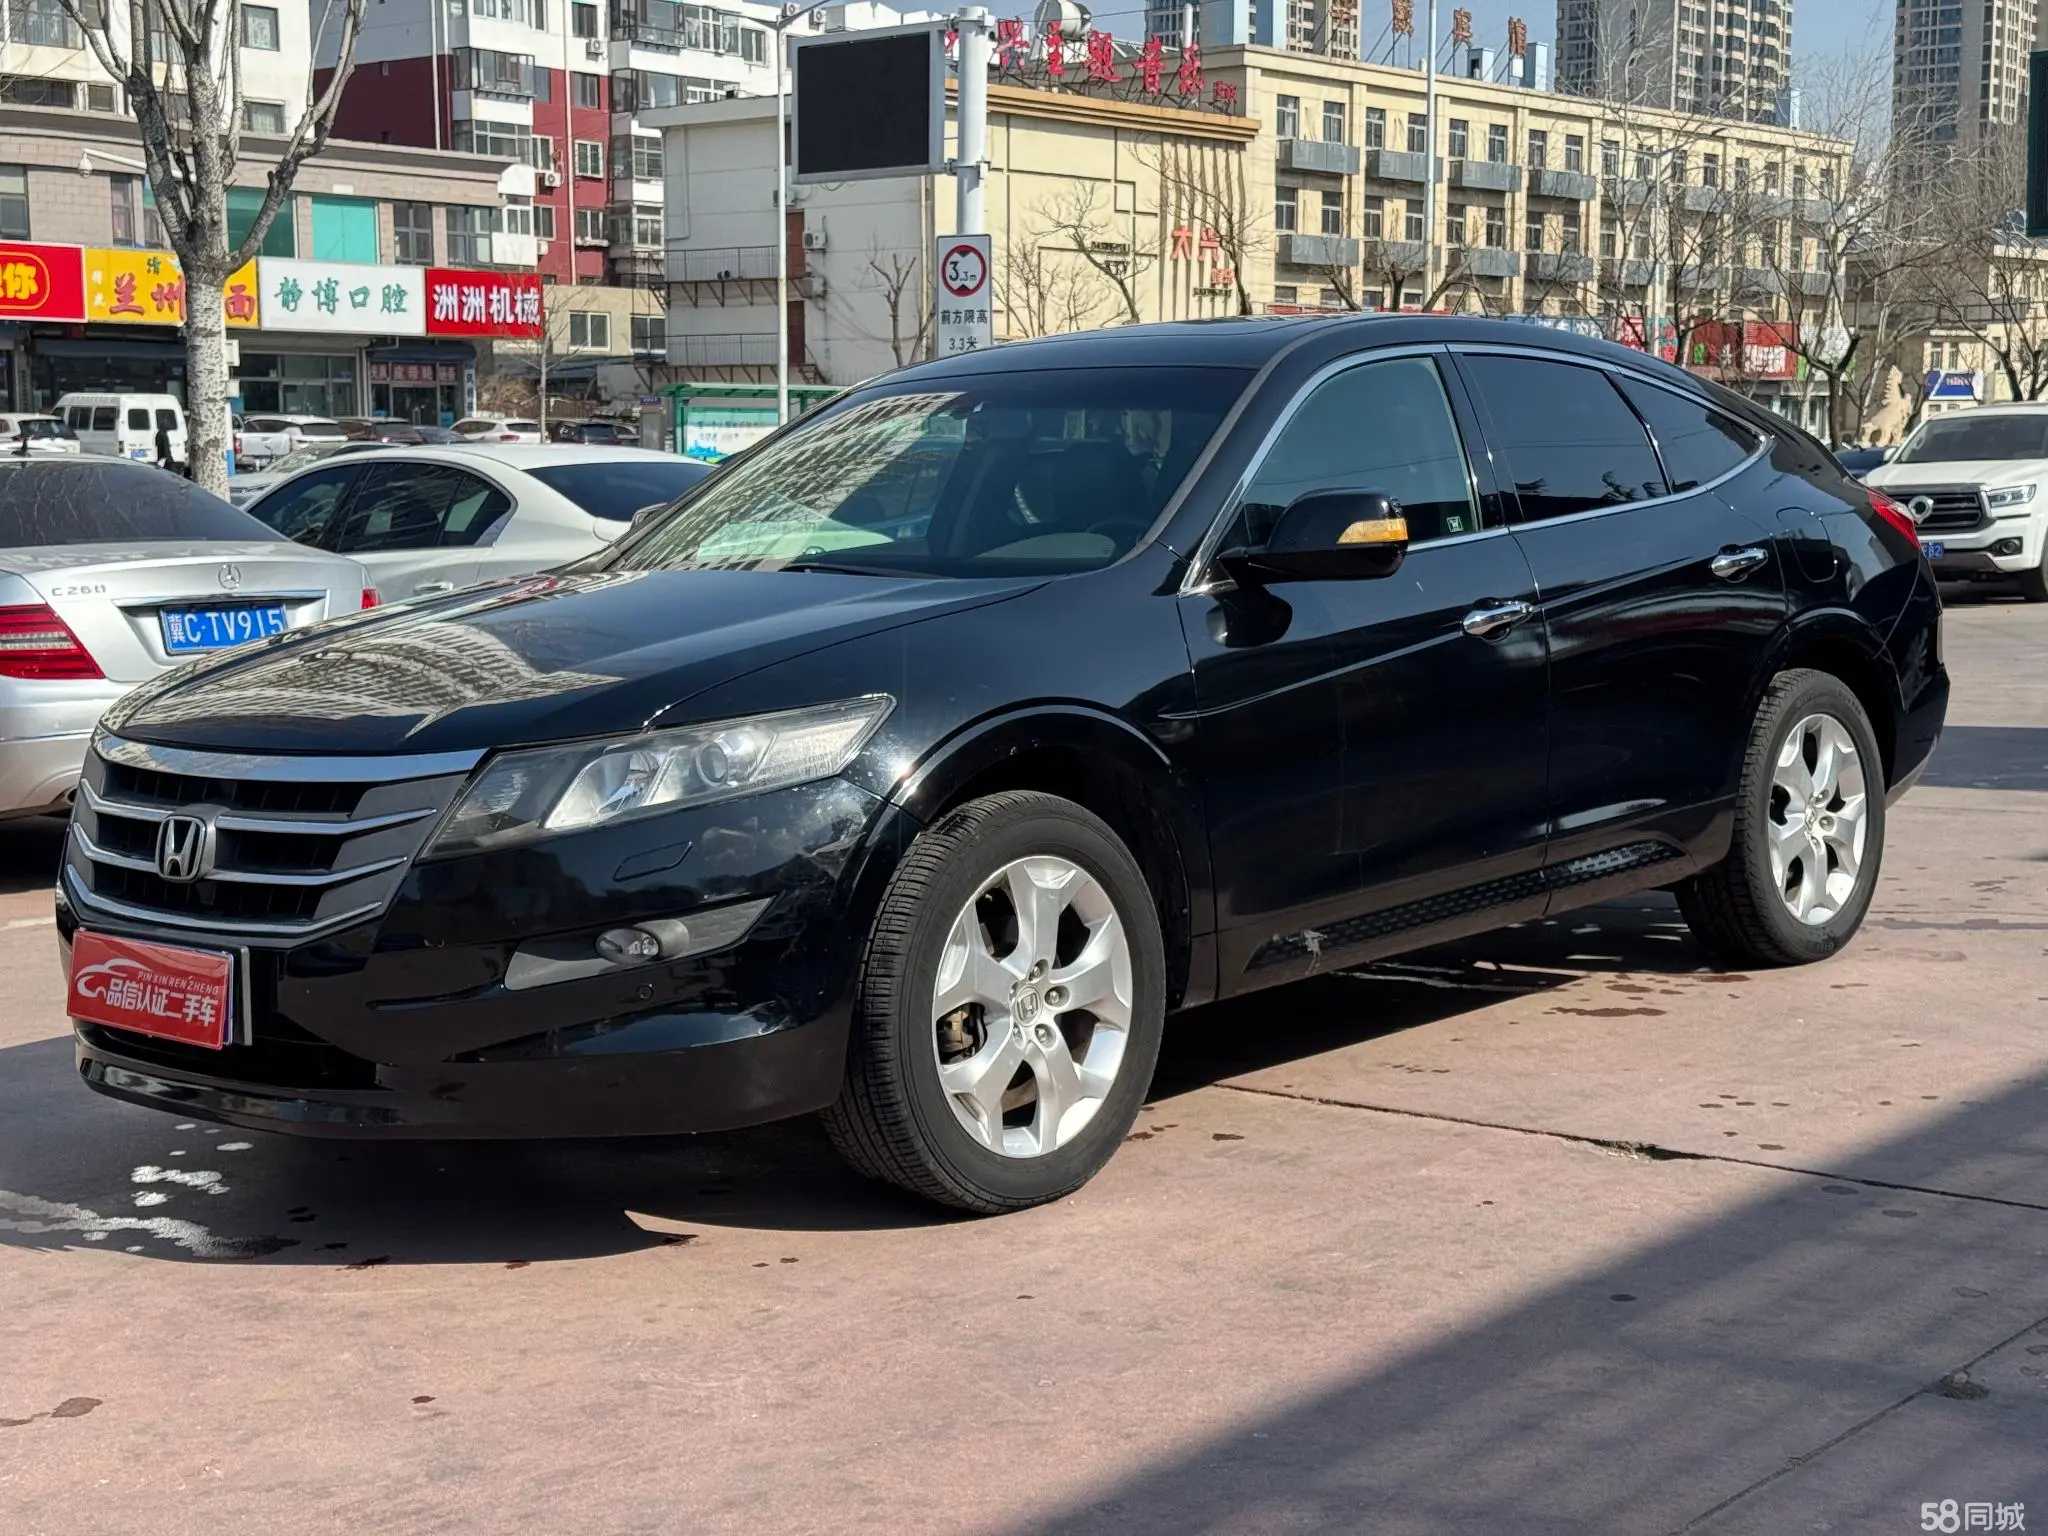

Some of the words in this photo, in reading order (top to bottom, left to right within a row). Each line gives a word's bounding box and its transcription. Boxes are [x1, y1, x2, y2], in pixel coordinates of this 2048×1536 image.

[274, 276, 409, 315] 静博口腔
[432, 284, 541, 326] 洲洲机械
[941, 309, 988, 325] 前方限高
[948, 336, 978, 351] 3.3米
[51, 587, 63, 597] C
[168, 977, 187, 989] REN
[187, 980, 219, 996] ZHENG
[106, 978, 219, 1028] 品信认证二手车
